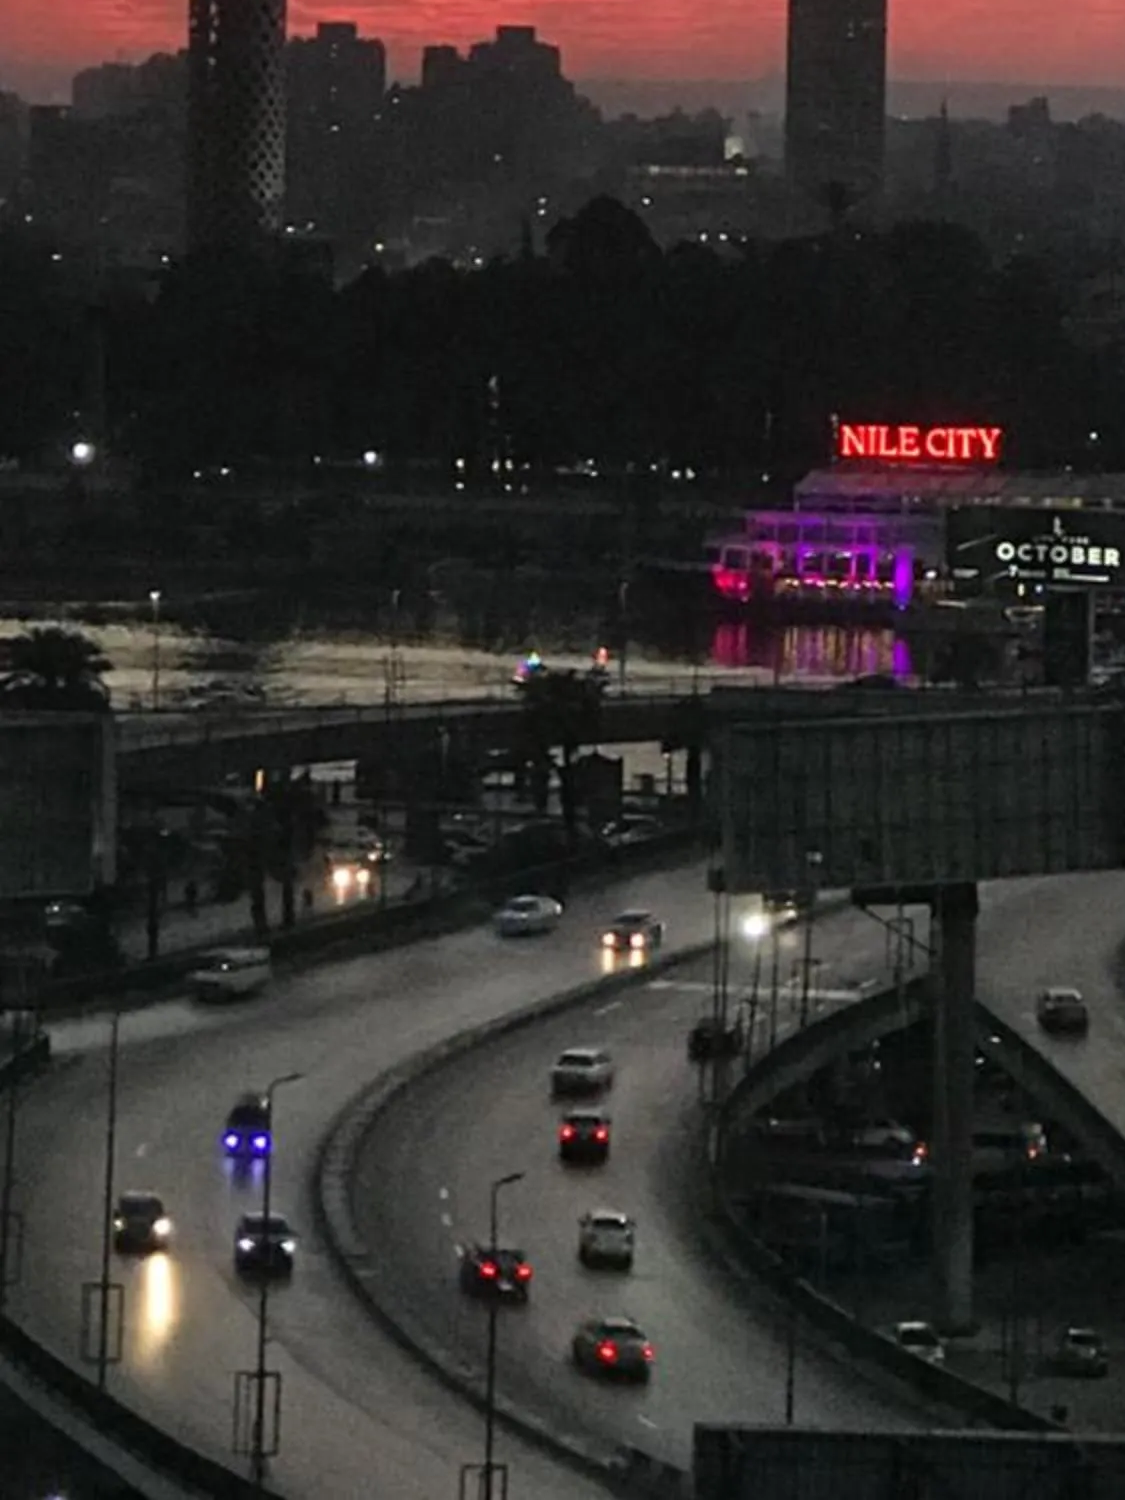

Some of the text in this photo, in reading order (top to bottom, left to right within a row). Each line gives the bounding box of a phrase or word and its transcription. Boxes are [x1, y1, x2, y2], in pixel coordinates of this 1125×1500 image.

[841, 424, 1002, 459] NILE CITY
[996, 541, 1121, 567] OCTOBER
